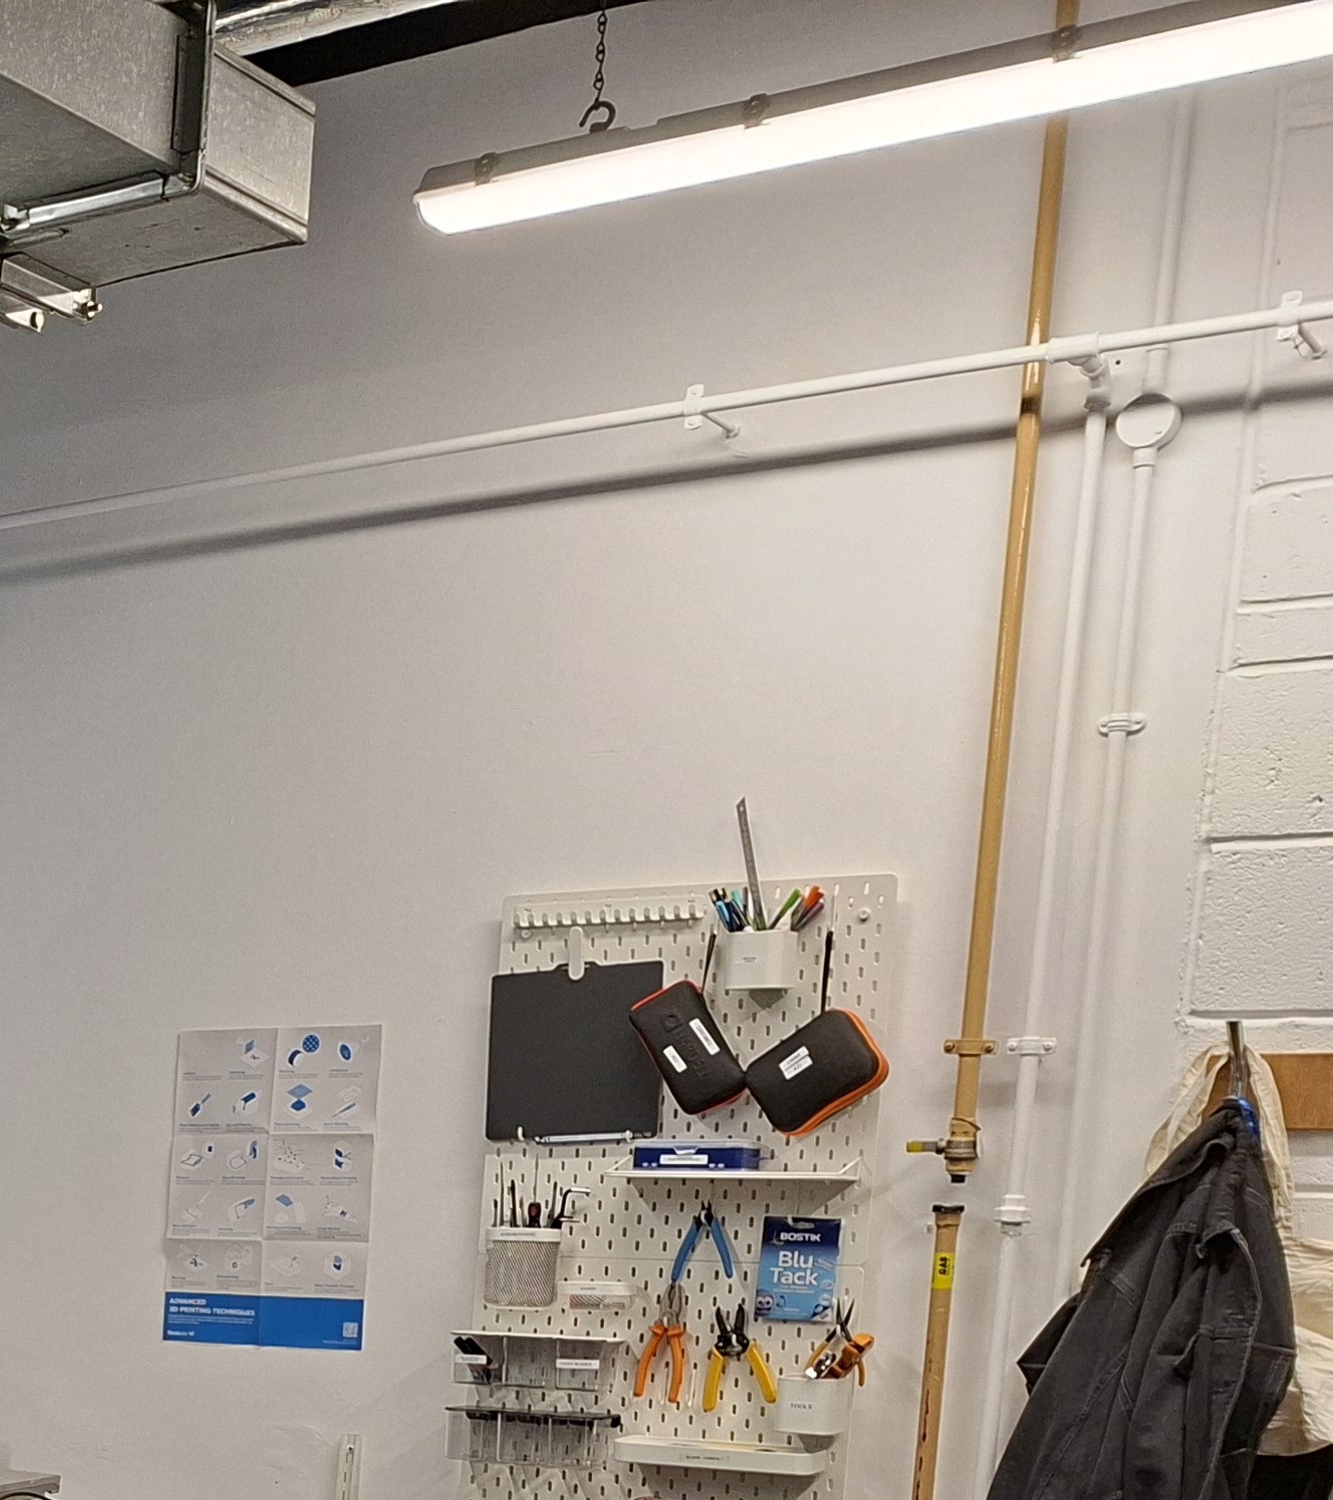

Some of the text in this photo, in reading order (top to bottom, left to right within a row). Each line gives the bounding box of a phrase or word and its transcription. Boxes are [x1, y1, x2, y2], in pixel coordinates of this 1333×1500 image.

[780, 1232, 822, 1243] BOSTIK
[778, 1250, 813, 1269] Blu
[770, 1267, 819, 1287] Tack
